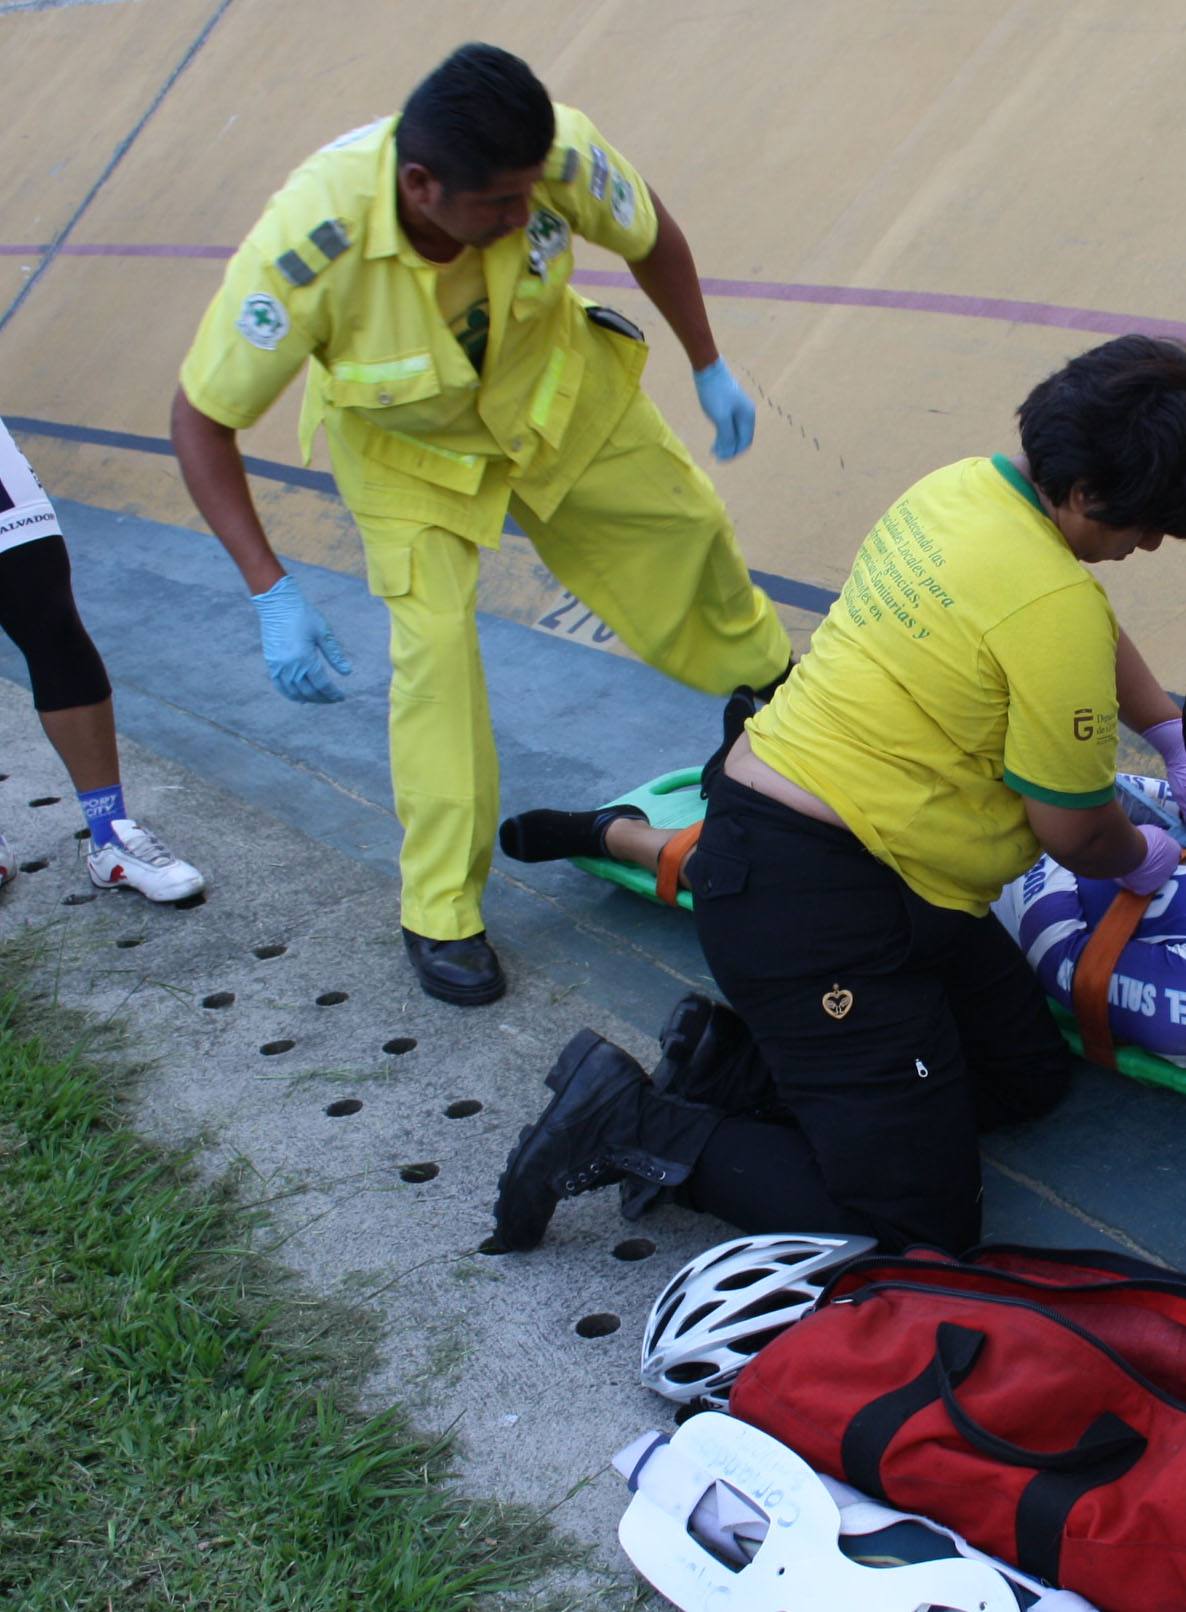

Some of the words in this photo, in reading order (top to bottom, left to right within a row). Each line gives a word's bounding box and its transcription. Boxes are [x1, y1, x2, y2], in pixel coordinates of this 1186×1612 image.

[897, 540, 927, 577] Locales
[919, 576, 955, 608] para
[928, 548, 946, 567] las
[868, 604, 883, 622] en
[871, 571, 917, 628] Sanitarias
[912, 627, 931, 640] y
